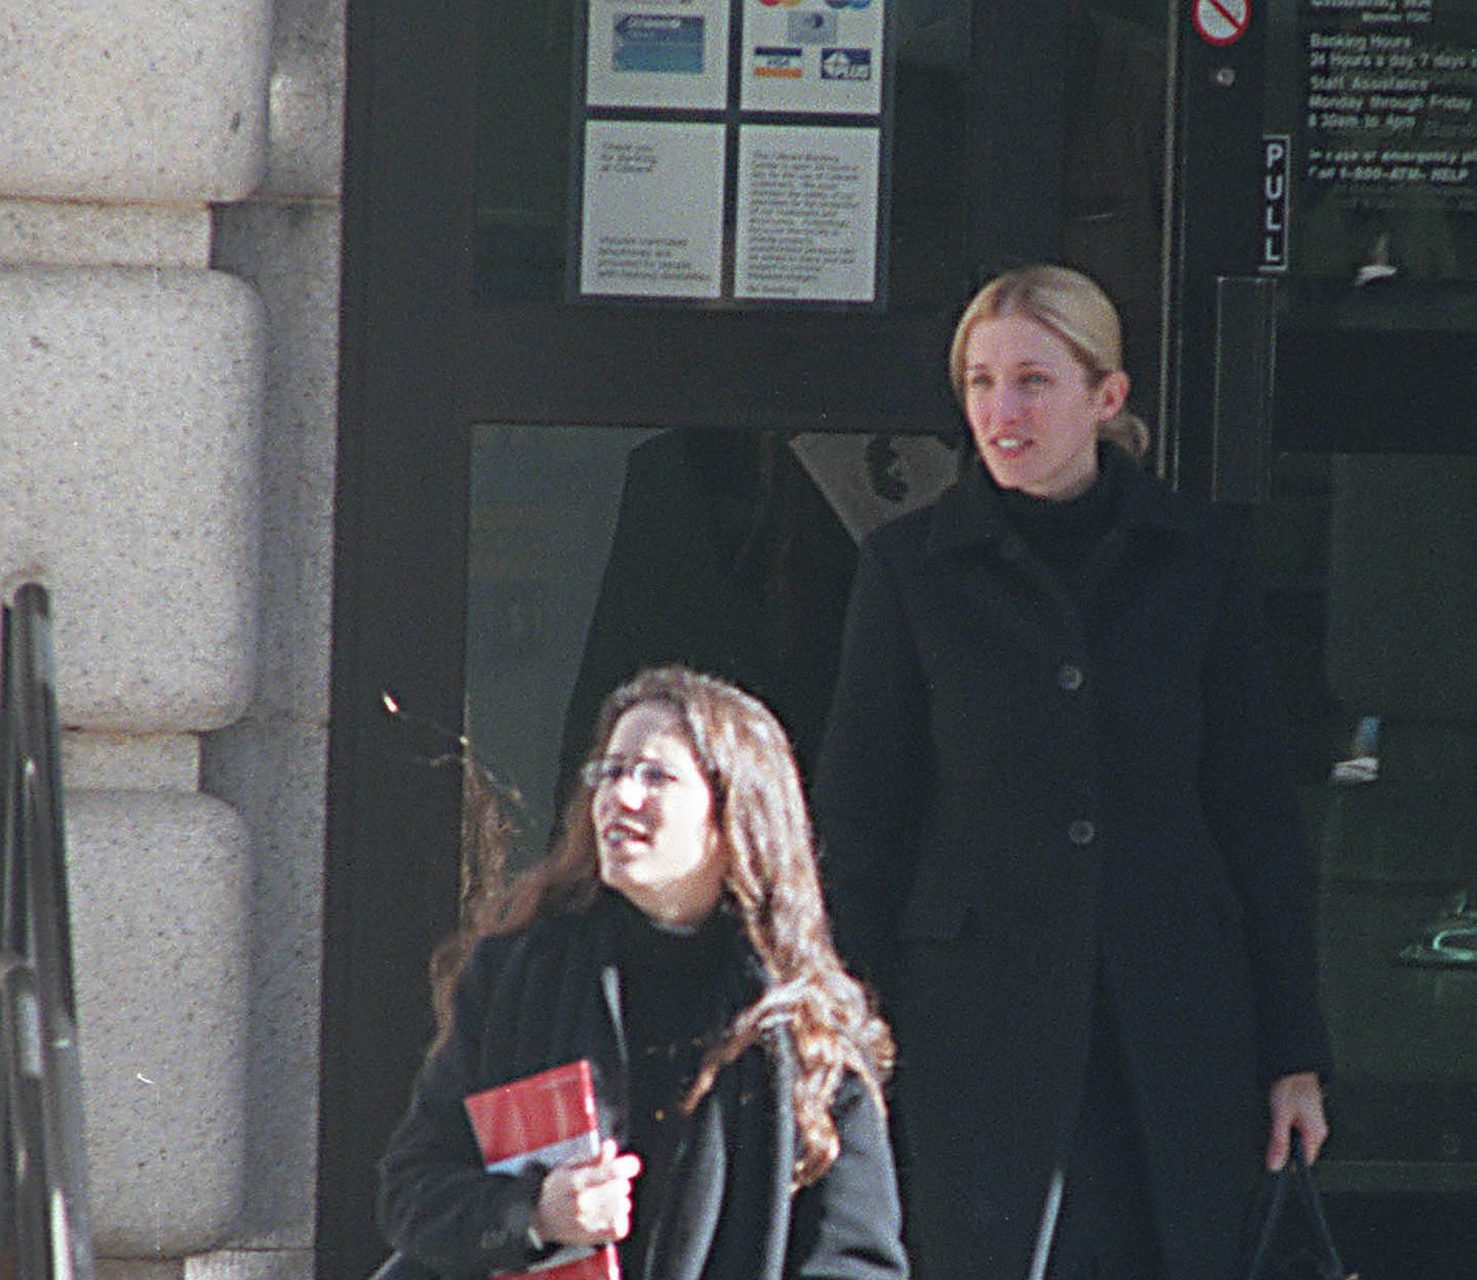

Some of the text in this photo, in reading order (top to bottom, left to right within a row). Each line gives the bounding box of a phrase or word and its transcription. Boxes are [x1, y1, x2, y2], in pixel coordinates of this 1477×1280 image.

[1310, 33, 1412, 50] Banking Hours
[1310, 76, 1430, 92] Staff Assistance
[1309, 94, 1473, 113] Monday through Friday
[1264, 142, 1284, 263] PULL
